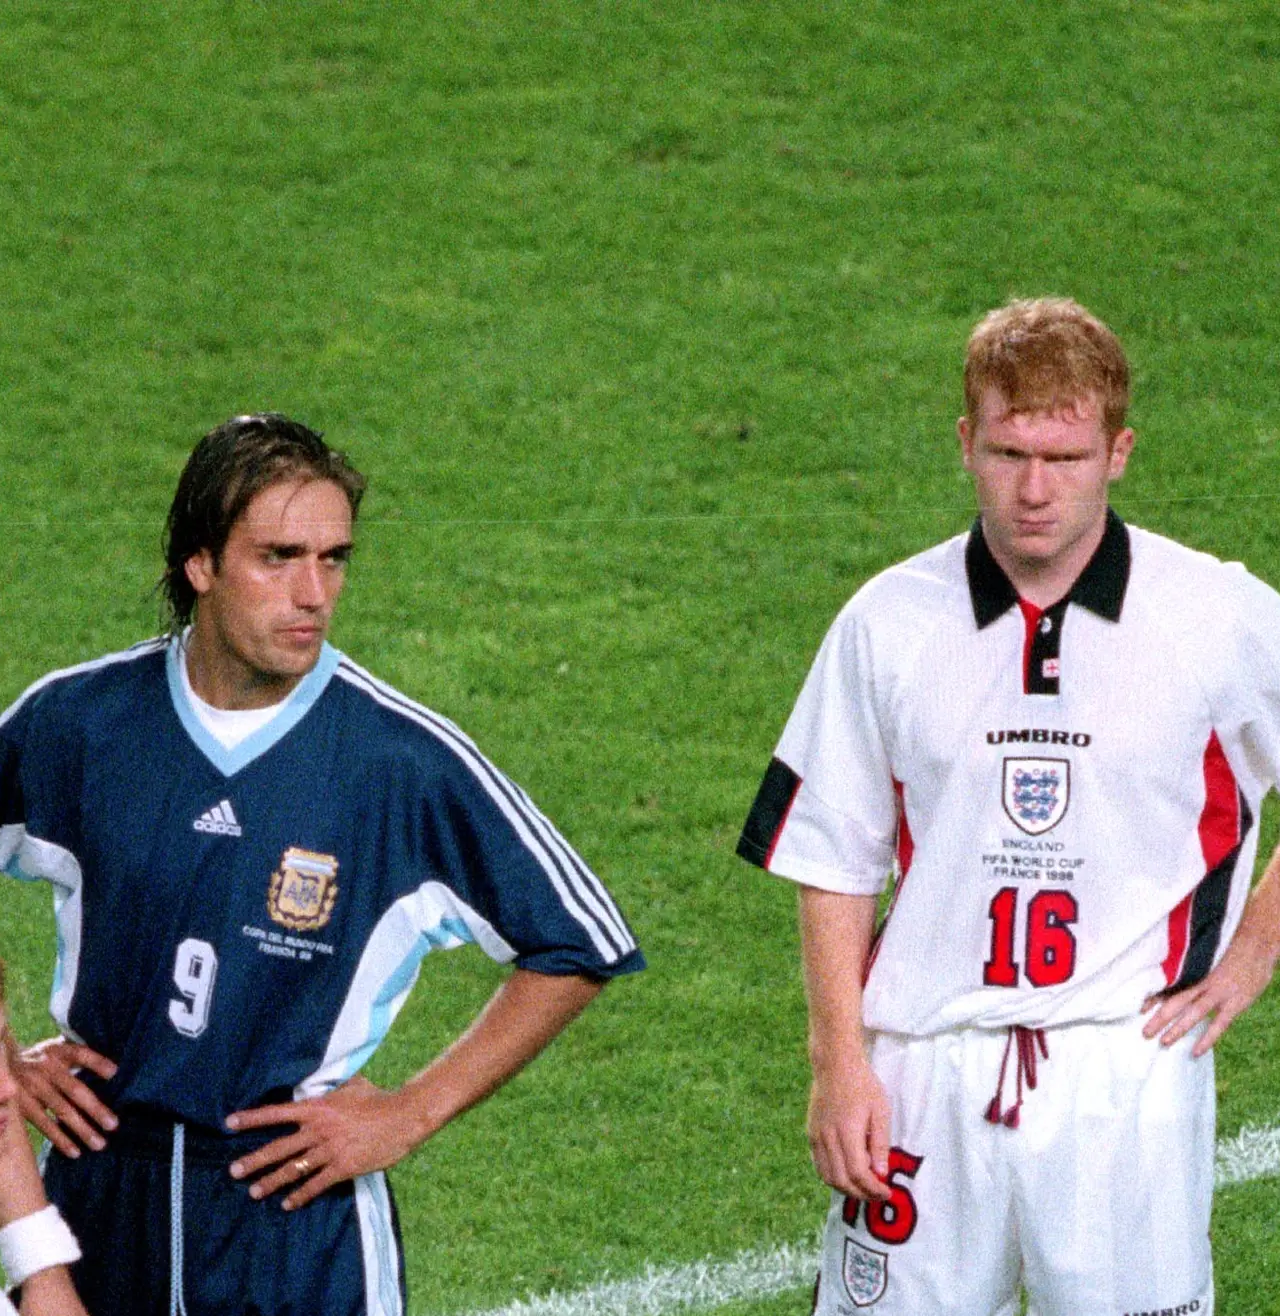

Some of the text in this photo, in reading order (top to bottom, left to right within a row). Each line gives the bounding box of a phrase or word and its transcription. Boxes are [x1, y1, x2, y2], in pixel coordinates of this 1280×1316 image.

[986, 729, 1092, 747] UMBRO
[1002, 838, 1065, 852] ENGLAND
[982, 855, 1085, 869] FIFA WORLD CUP
[993, 867, 1040, 880] FRANCE
[982, 887, 1079, 988] 16
[169, 938, 218, 1038] 9
